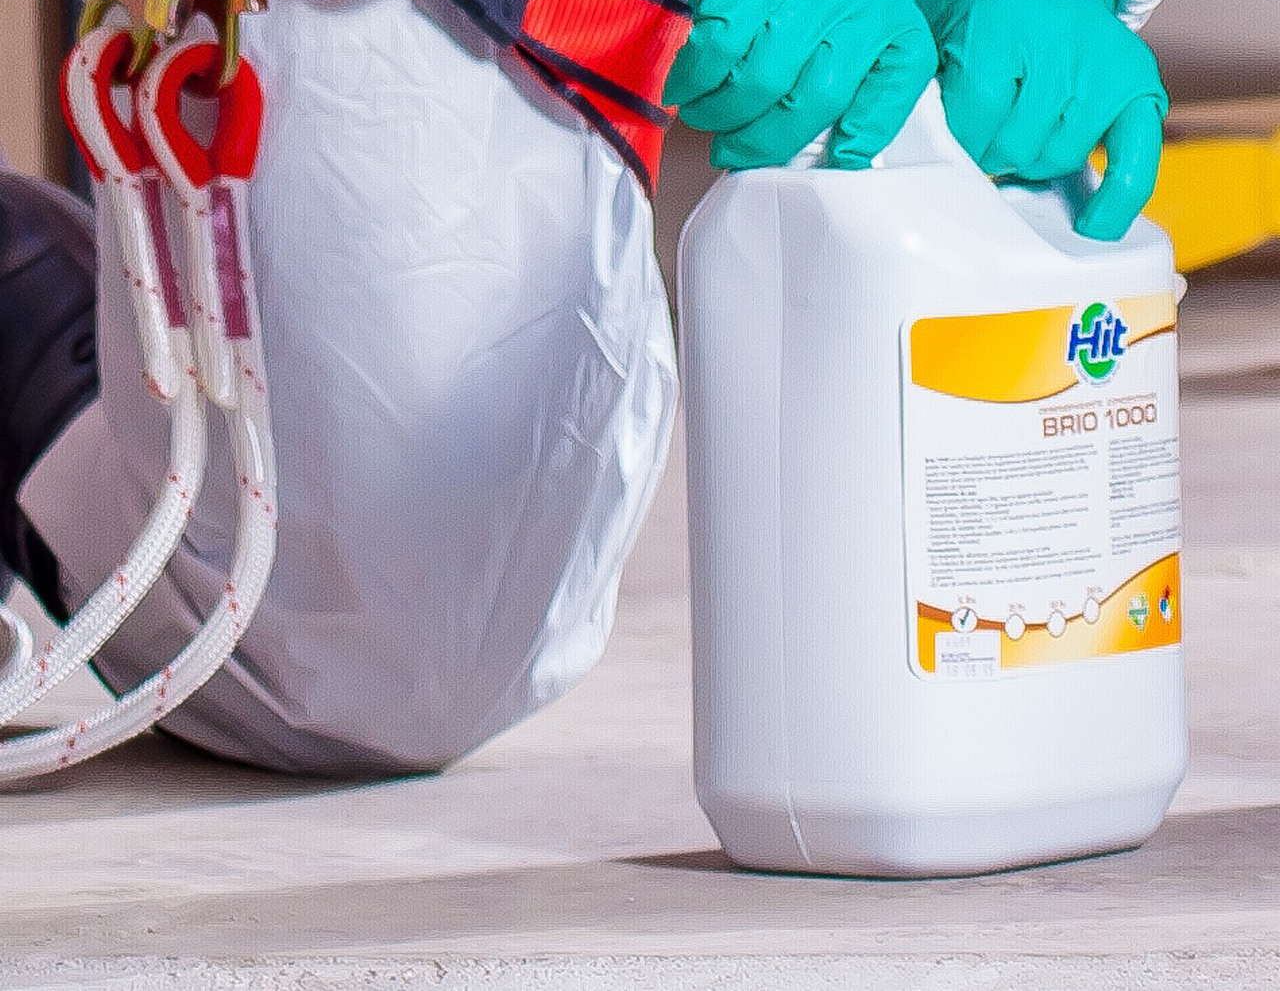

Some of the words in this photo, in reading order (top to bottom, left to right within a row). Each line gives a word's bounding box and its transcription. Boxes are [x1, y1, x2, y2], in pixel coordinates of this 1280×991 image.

[1067, 310, 1128, 362] Hit
[1042, 411, 1098, 438] BRIO
[1105, 403, 1158, 430] 1000
